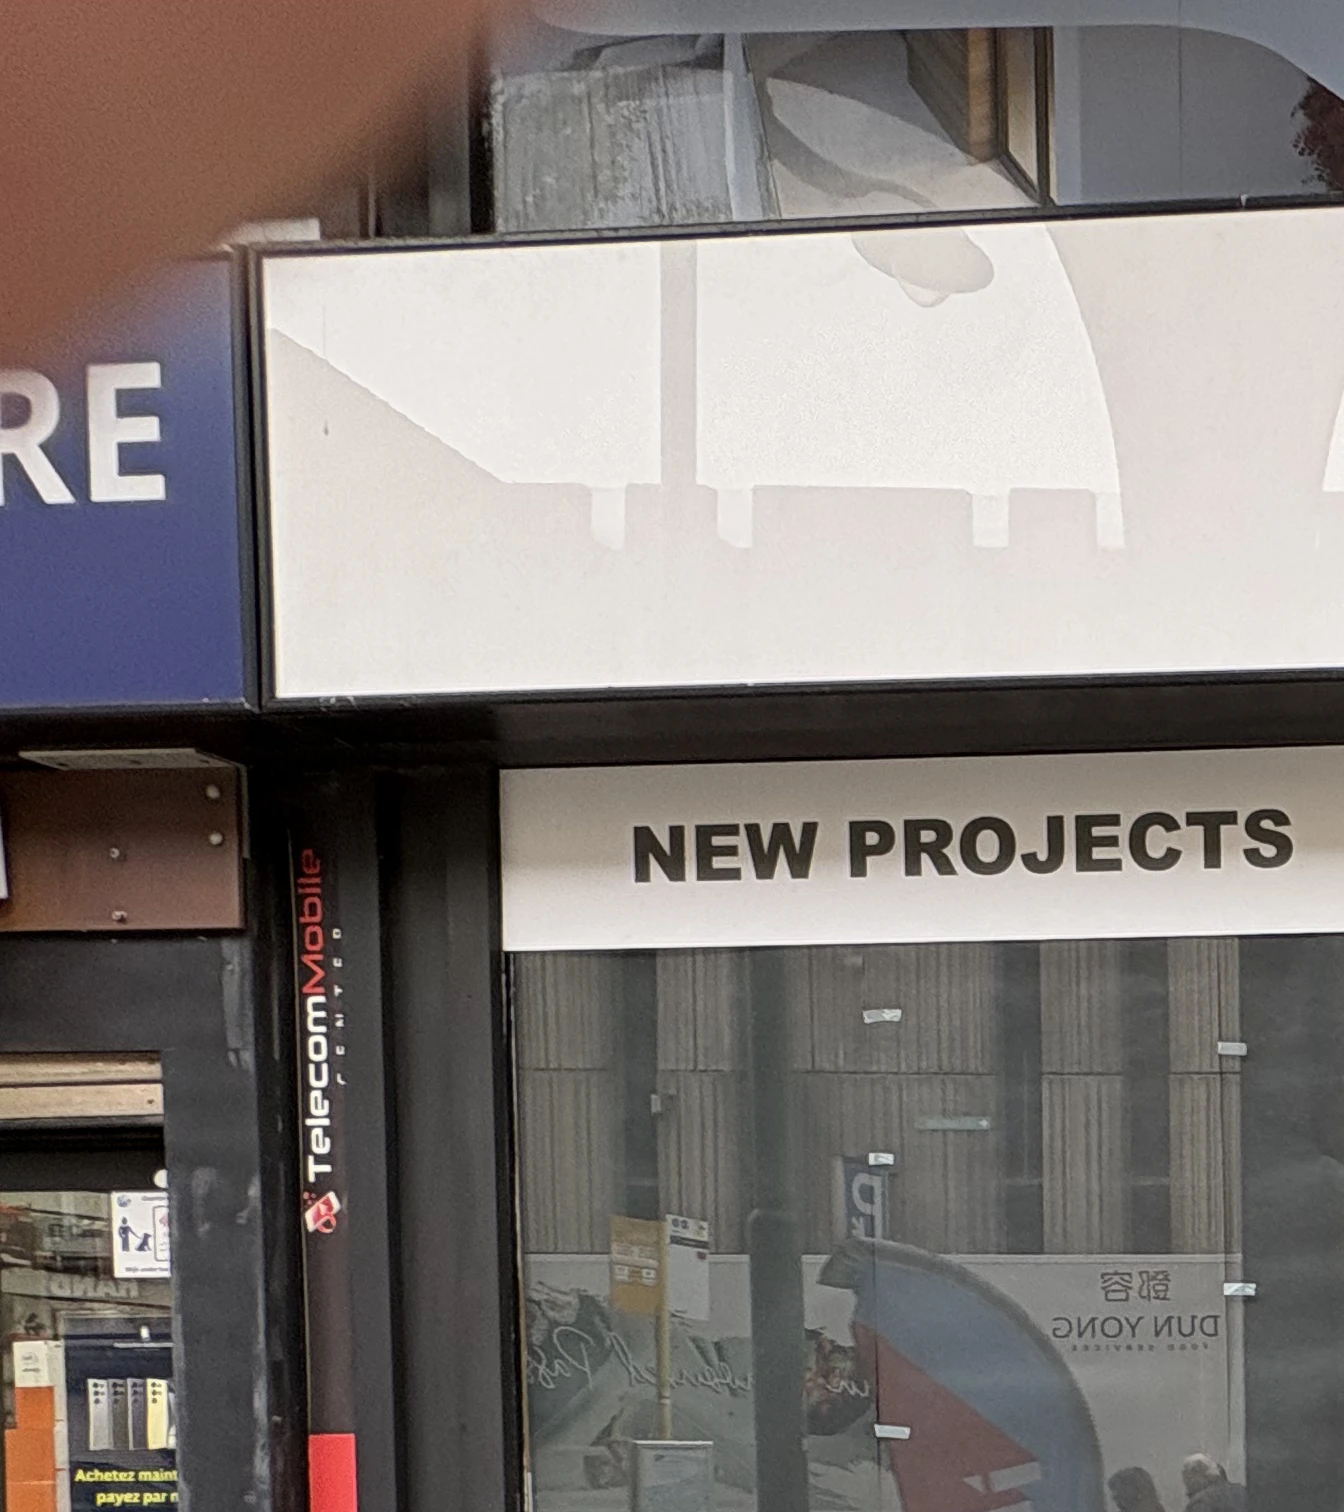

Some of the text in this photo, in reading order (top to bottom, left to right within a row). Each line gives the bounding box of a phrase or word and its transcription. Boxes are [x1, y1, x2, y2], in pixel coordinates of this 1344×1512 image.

[633, 808, 1294, 883] NEW PROJECTS
[297, 848, 332, 1183] TelecomMobile
[75, 1469, 136, 1483] Achetez
[96, 1492, 140, 1508] payez
[142, 1493, 167, 1507] par
